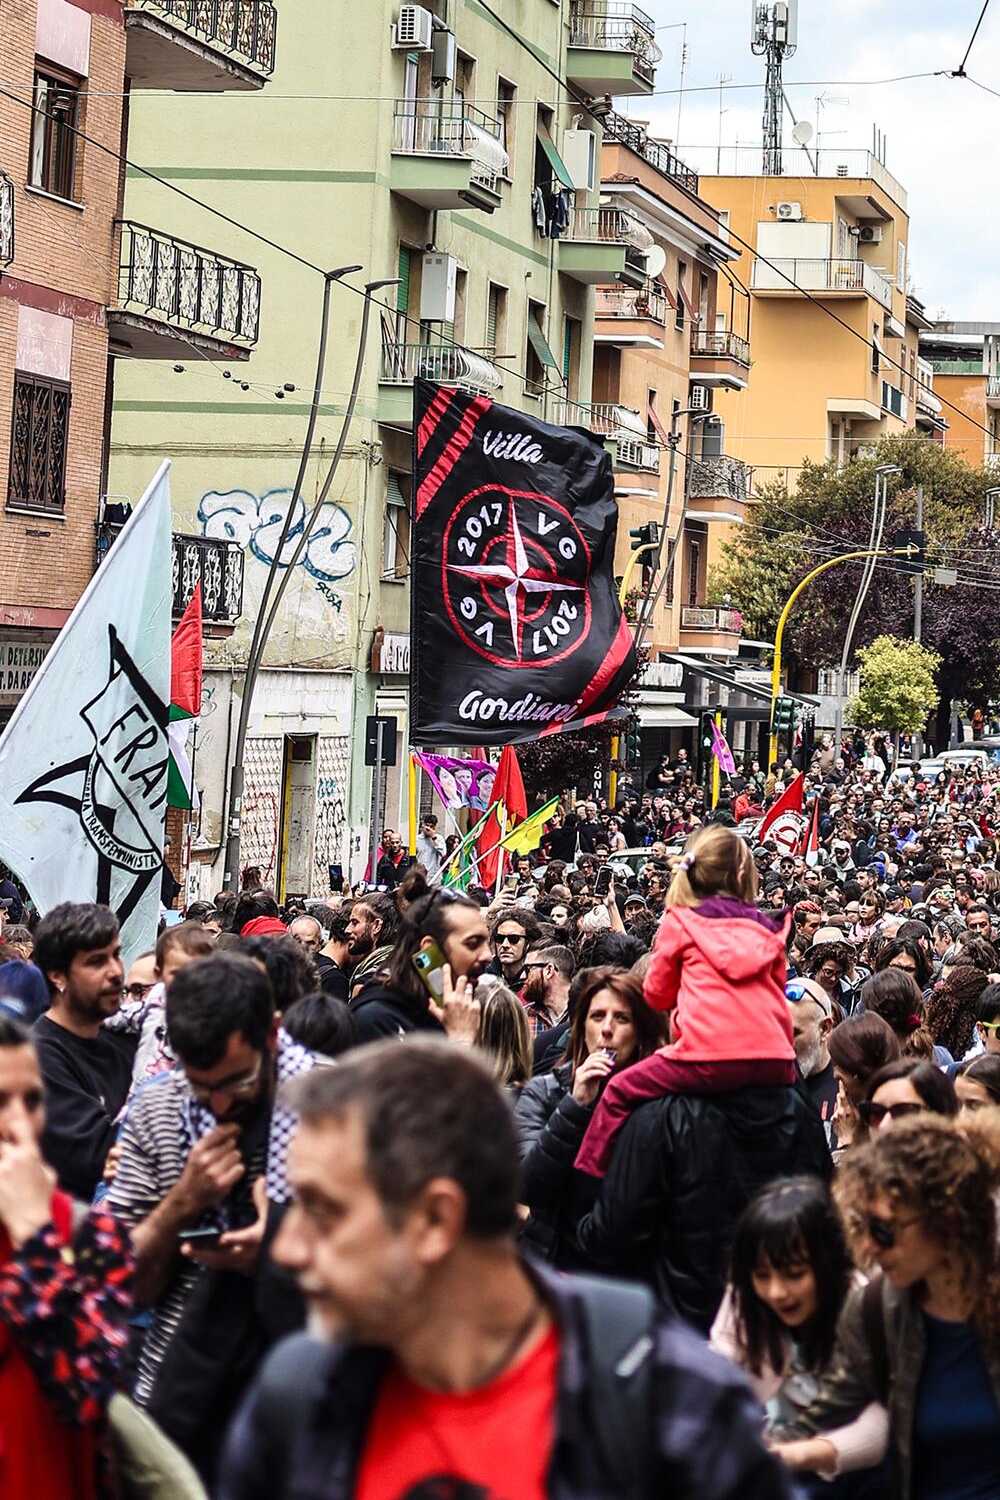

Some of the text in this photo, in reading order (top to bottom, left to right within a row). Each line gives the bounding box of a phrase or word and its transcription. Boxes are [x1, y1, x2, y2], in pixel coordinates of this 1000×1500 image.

[483, 430, 543, 463] Villa
[457, 502, 503, 558] 2017
[315, 581, 343, 613] SCUSA
[532, 599, 578, 655] 2017
[7, 670, 19, 690] DA
[458, 690, 584, 723] Gordiani
